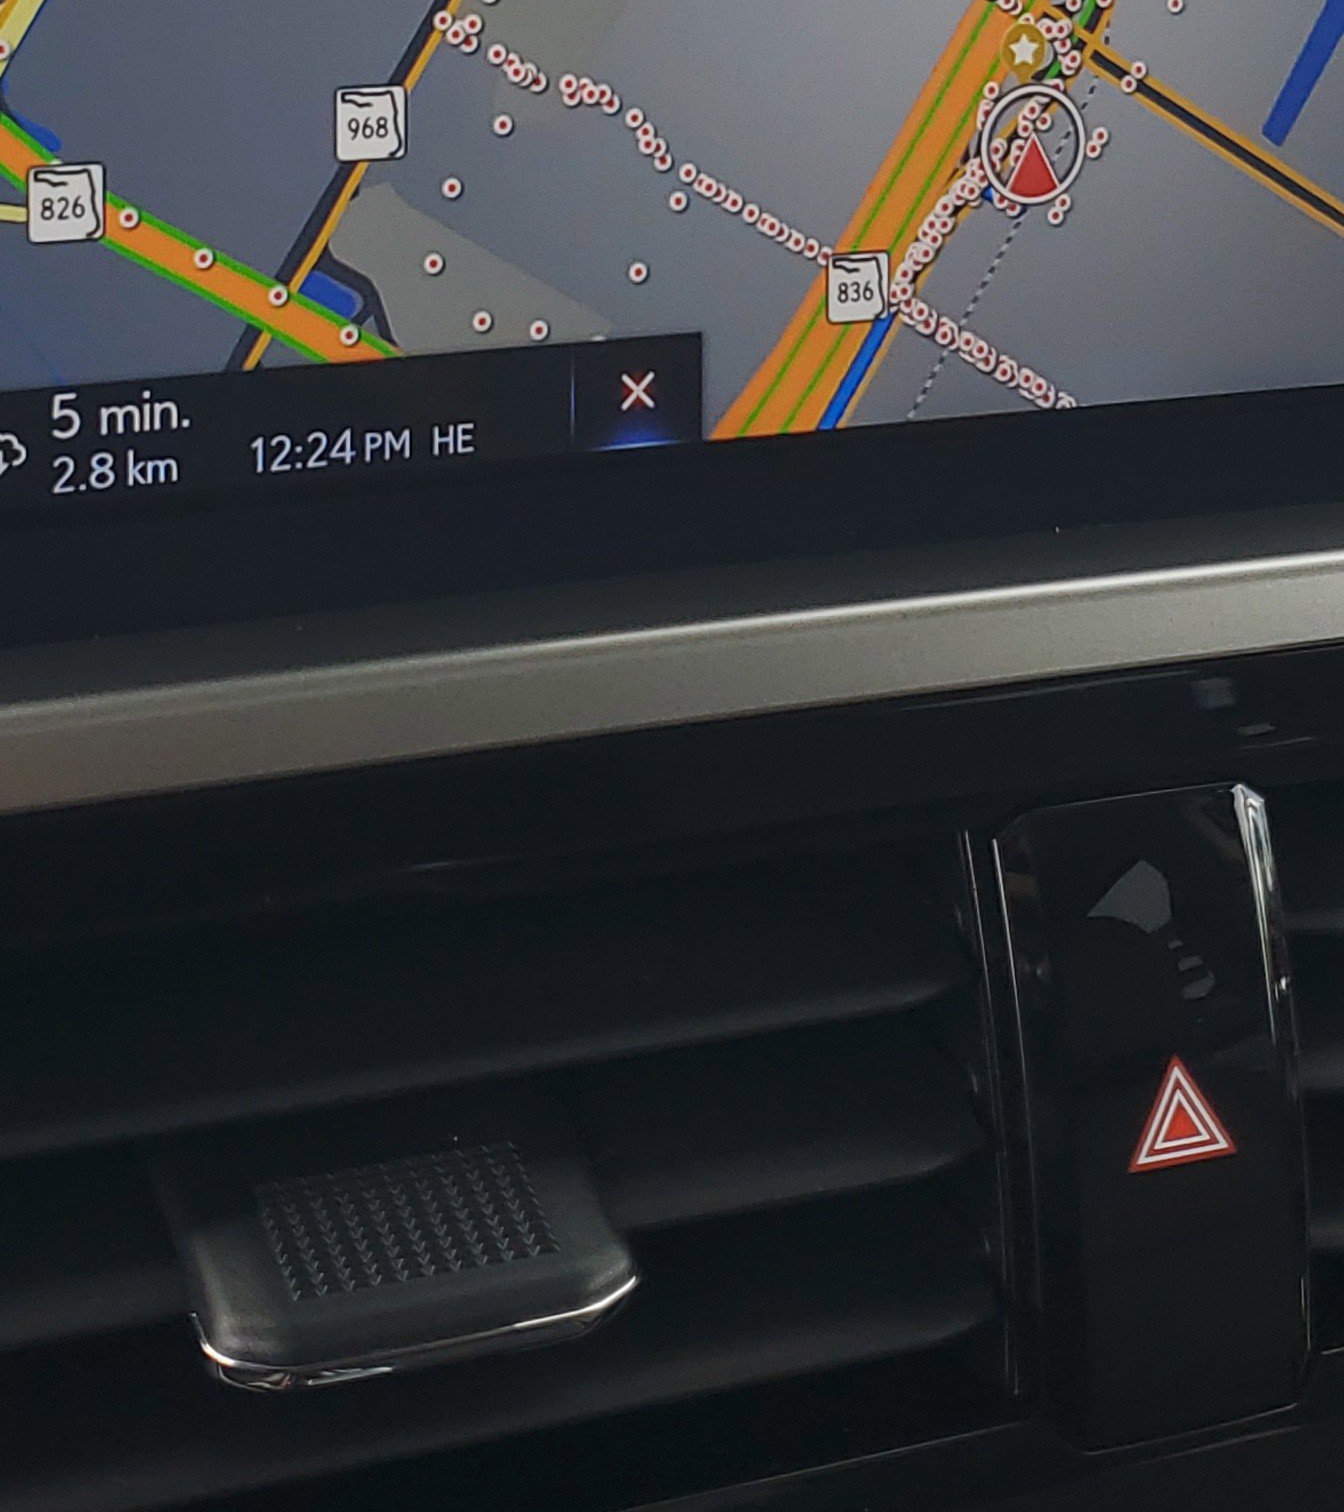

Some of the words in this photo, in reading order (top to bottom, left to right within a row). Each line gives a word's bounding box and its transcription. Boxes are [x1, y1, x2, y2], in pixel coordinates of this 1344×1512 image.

[347, 116, 390, 142] 968
[39, 194, 86, 221] 826
[836, 280, 874, 304] 836
[51, 391, 82, 439] 5
[99, 390, 191, 437] min.
[250, 427, 356, 474] 12:24
[363, 428, 412, 463] PM
[431, 422, 476, 457] HE
[52, 451, 116, 495] 2.8
[127, 449, 179, 487] km
